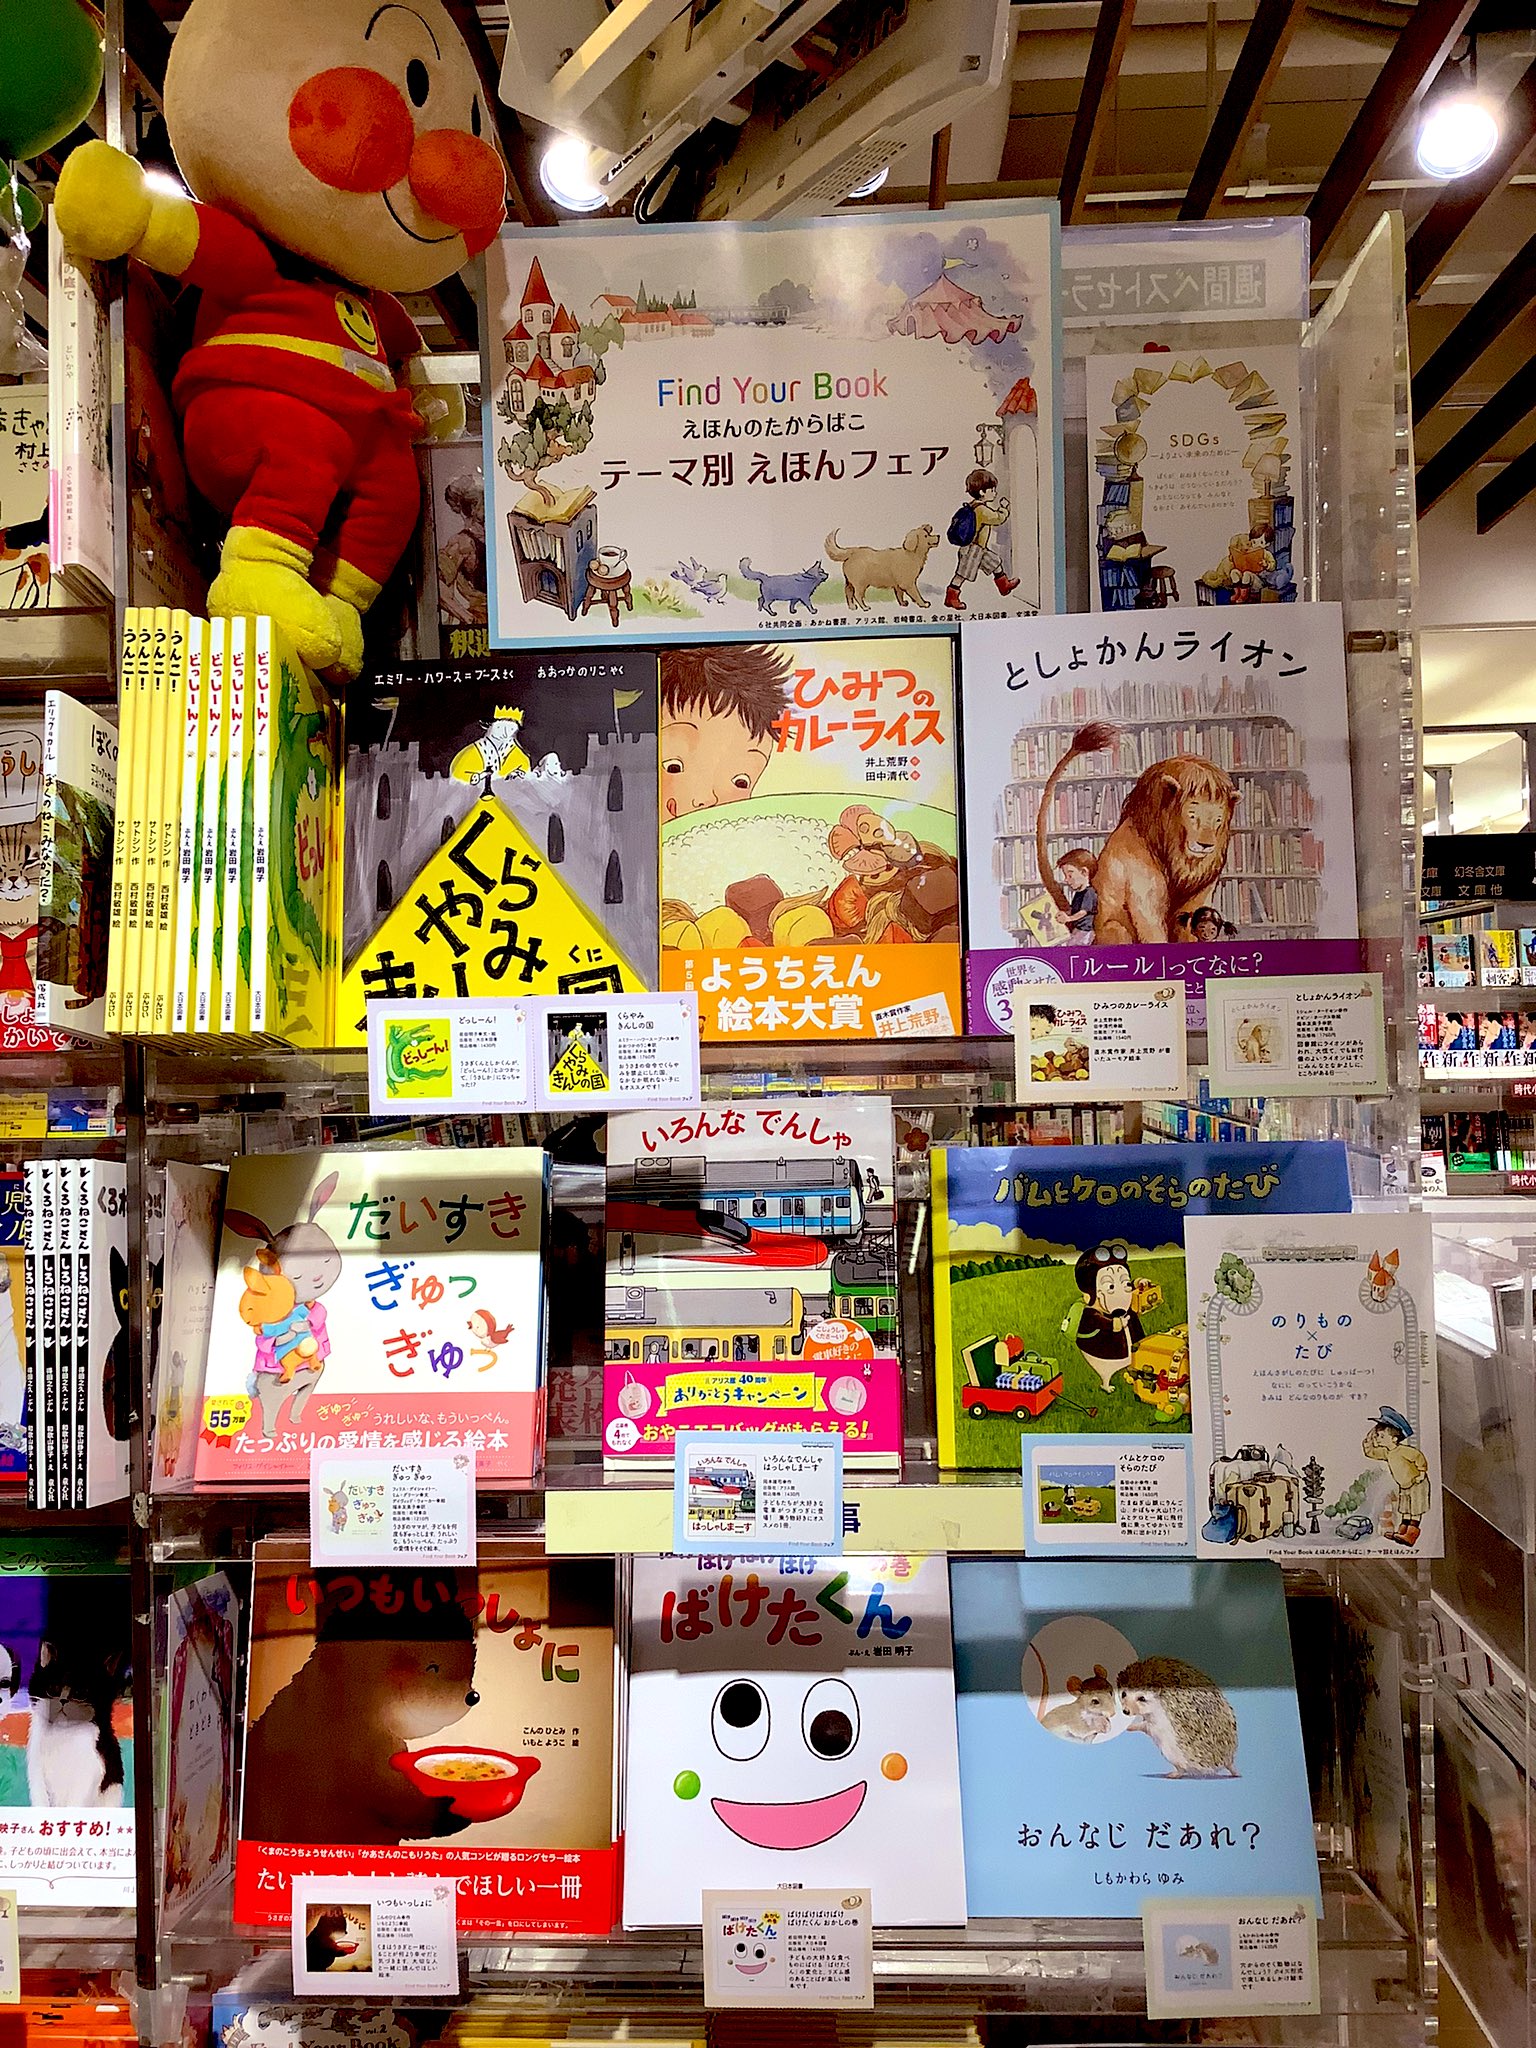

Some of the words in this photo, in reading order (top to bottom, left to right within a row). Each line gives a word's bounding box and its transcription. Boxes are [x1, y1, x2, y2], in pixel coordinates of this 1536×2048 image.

[657, 377, 720, 406] Find
[732, 376, 802, 404] Your
[813, 370, 889, 400] Book
[683, 412, 865, 439] えほんのたからばこ
[1170, 433, 1219, 447] SDGs
[601, 451, 732, 490] テーマ別
[747, 446, 949, 485] えほんフェア
[1005, 630, 1308, 692] としょかんライオン
[793, 669, 935, 709] ひみつの
[771, 710, 945, 753] カレーライス
[865, 756, 909, 768] 井上荒野
[865, 770, 910, 782] 田中清代
[1455, 866, 1505, 878] 幻冬舎文庫
[702, 954, 882, 993] ようちえん
[718, 995, 864, 1032] 絵本大賞
[1093, 1002, 1168, 1010] ひみつのカレーライス
[459, 1016, 497, 1024] どっしーん!
[618, 1022, 654, 1030] きんしの国
[642, 1110, 746, 1153] いろんな
[756, 1110, 852, 1151] でんしゃ
[994, 1163, 1281, 1208] バムとケロのそらのたび
[348, 1191, 527, 1244] だいすき
[365, 1261, 477, 1310] ぎゅっ
[1271, 1313, 1353, 1329] のりもの
[383, 1329, 499, 1379] ぎゅっ
[1295, 1344, 1333, 1360] たび
[739, 1374, 754, 1384] 40
[674, 1387, 807, 1403] ありがとうキャンペーン
[209, 1410, 231, 1428] 55
[373, 1409, 511, 1426] うれしいな、もういっぺん。
[235, 1428, 509, 1455] たっぷりの愛情を感じる絵本
[763, 1455, 823, 1463] いろんなでんしゃ
[1119, 1454, 1165, 1462] バムとケロの
[1119, 1464, 1157, 1472] そらのたび
[660, 1571, 913, 1645] ばけたくん
[286, 1574, 581, 1683] いつもいっしょに
[873, 1646, 892, 1656] 岩田
[895, 1646, 914, 1656] 明子
[39, 1820, 111, 1837] おすすめ!
[1017, 1822, 1127, 1850] おんなじ
[1146, 1821, 1261, 1850] だあれ?
[1094, 1872, 1151, 1885] しもかわら
[1158, 1872, 1185, 1885] ゆみ
